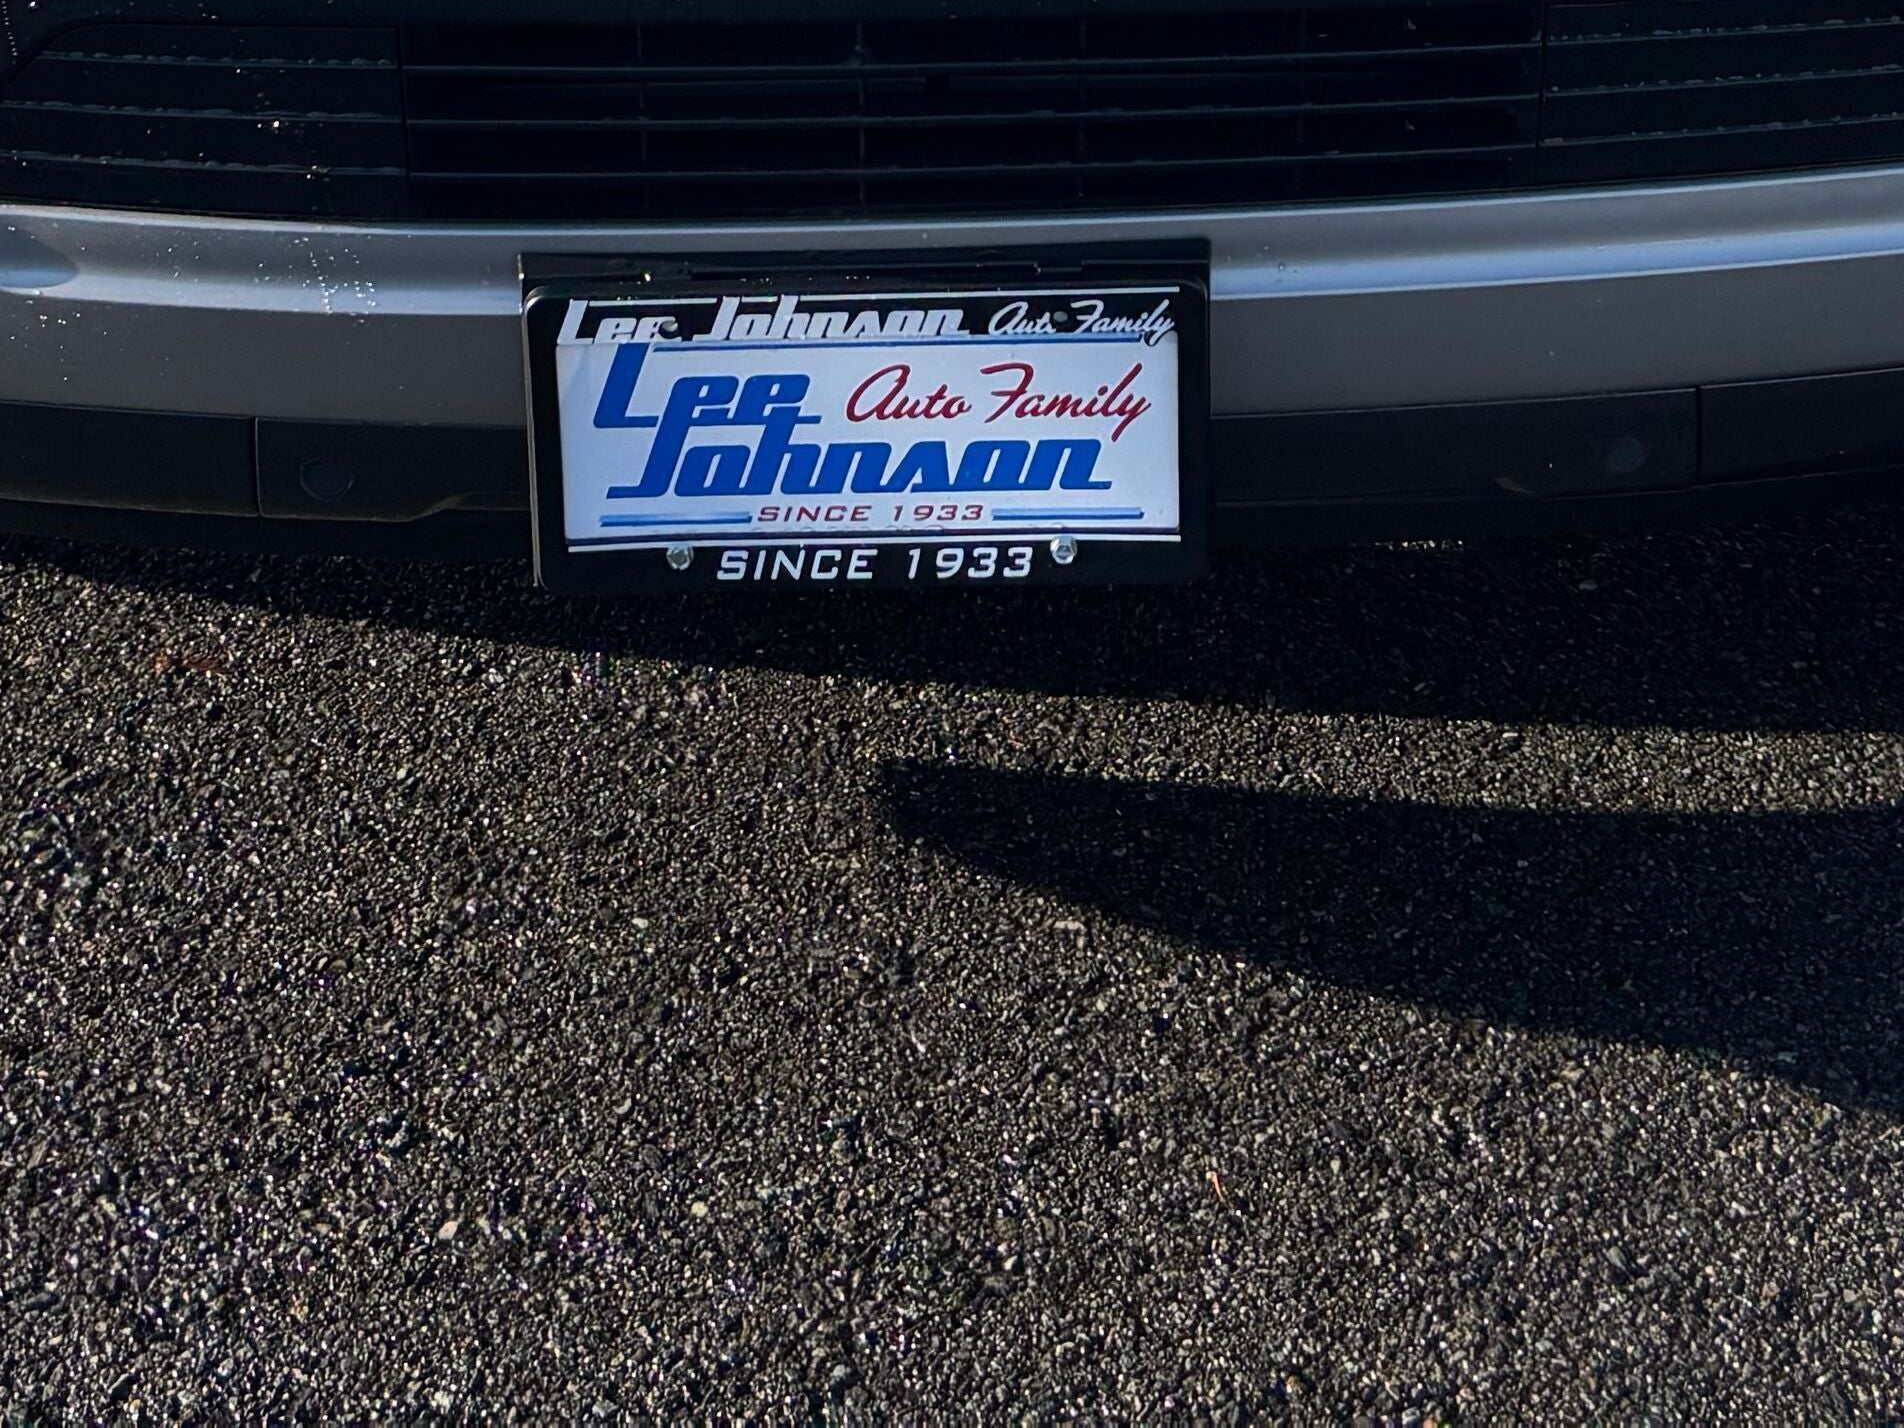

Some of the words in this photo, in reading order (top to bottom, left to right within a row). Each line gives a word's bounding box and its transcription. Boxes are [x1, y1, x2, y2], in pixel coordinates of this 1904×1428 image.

[557, 298, 682, 344] Lee
[692, 295, 970, 341] Johnson
[1070, 298, 1175, 345] Family
[593, 343, 823, 428] Lee
[845, 363, 973, 423] Auto
[979, 361, 1152, 443] Family
[606, 404, 1113, 500] Johnson
[757, 505, 873, 523] SINCE
[893, 504, 984, 522] 1933
[716, 547, 879, 581] SINCE
[907, 546, 1034, 580] 1933
